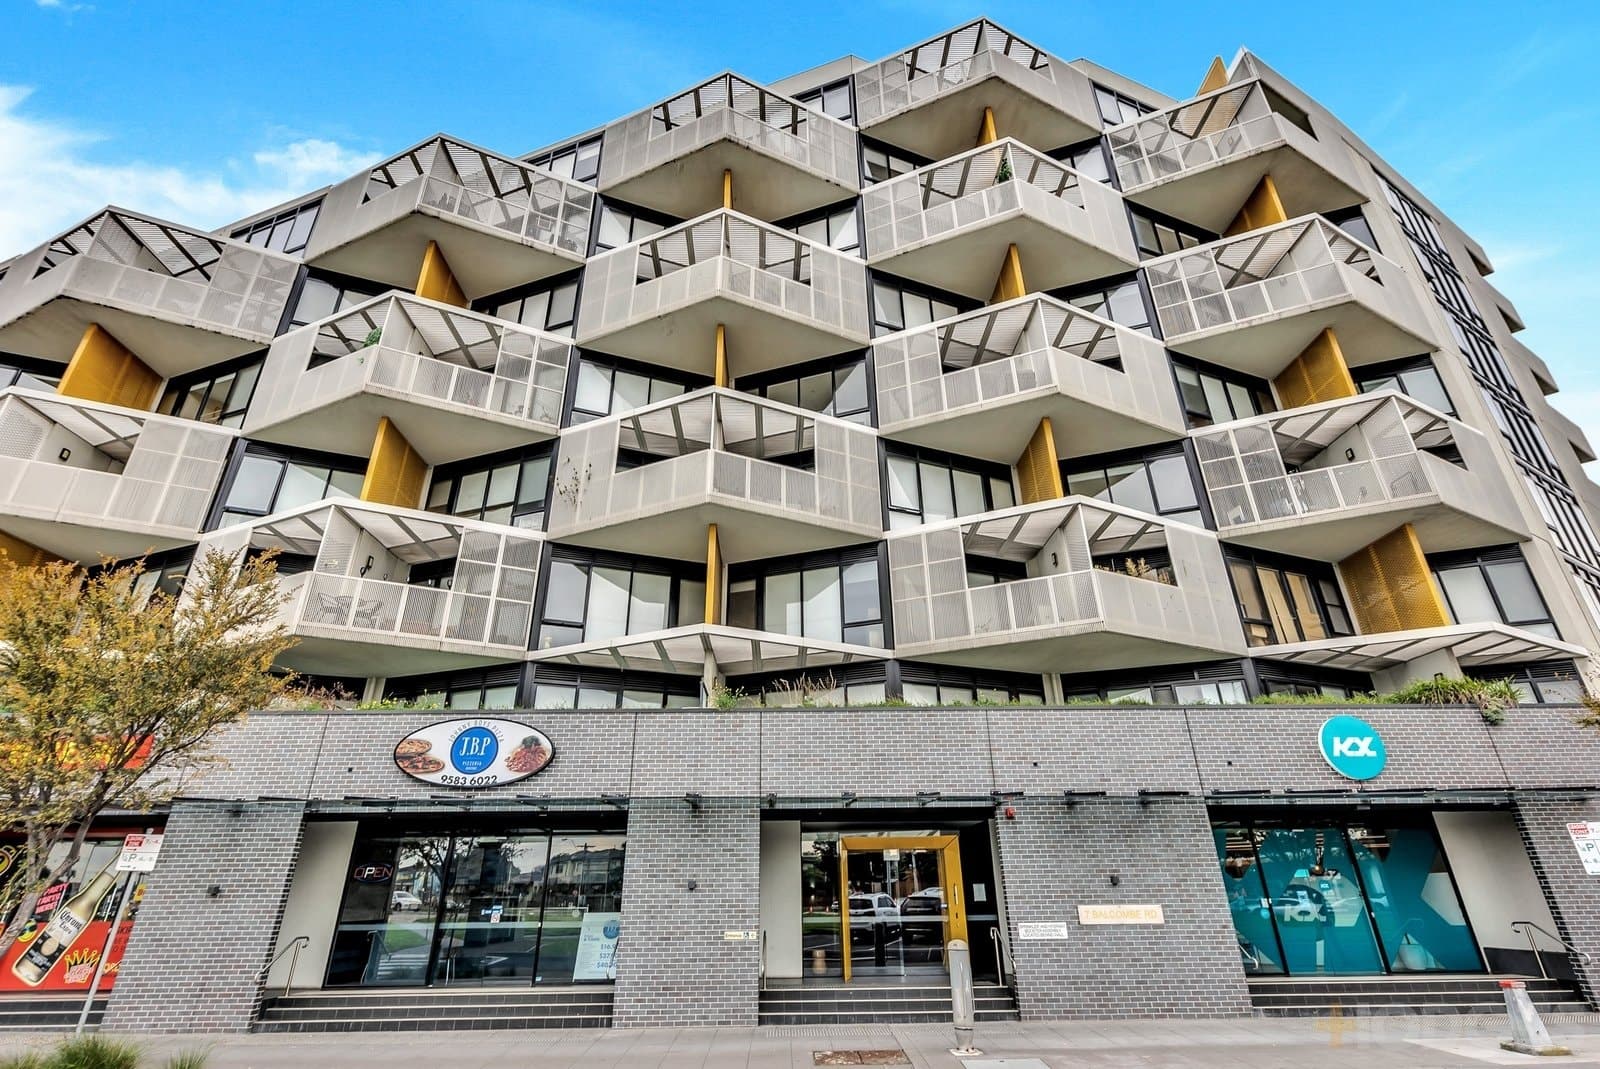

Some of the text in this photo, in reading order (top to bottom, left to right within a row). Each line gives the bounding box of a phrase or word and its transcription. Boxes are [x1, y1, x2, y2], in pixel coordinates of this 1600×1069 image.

[441, 774, 498, 786] 9583 6022
[353, 866, 394, 879] OPEN
[1092, 909, 1142, 920] BALCOMBE
[1144, 909, 1158, 920] RD
